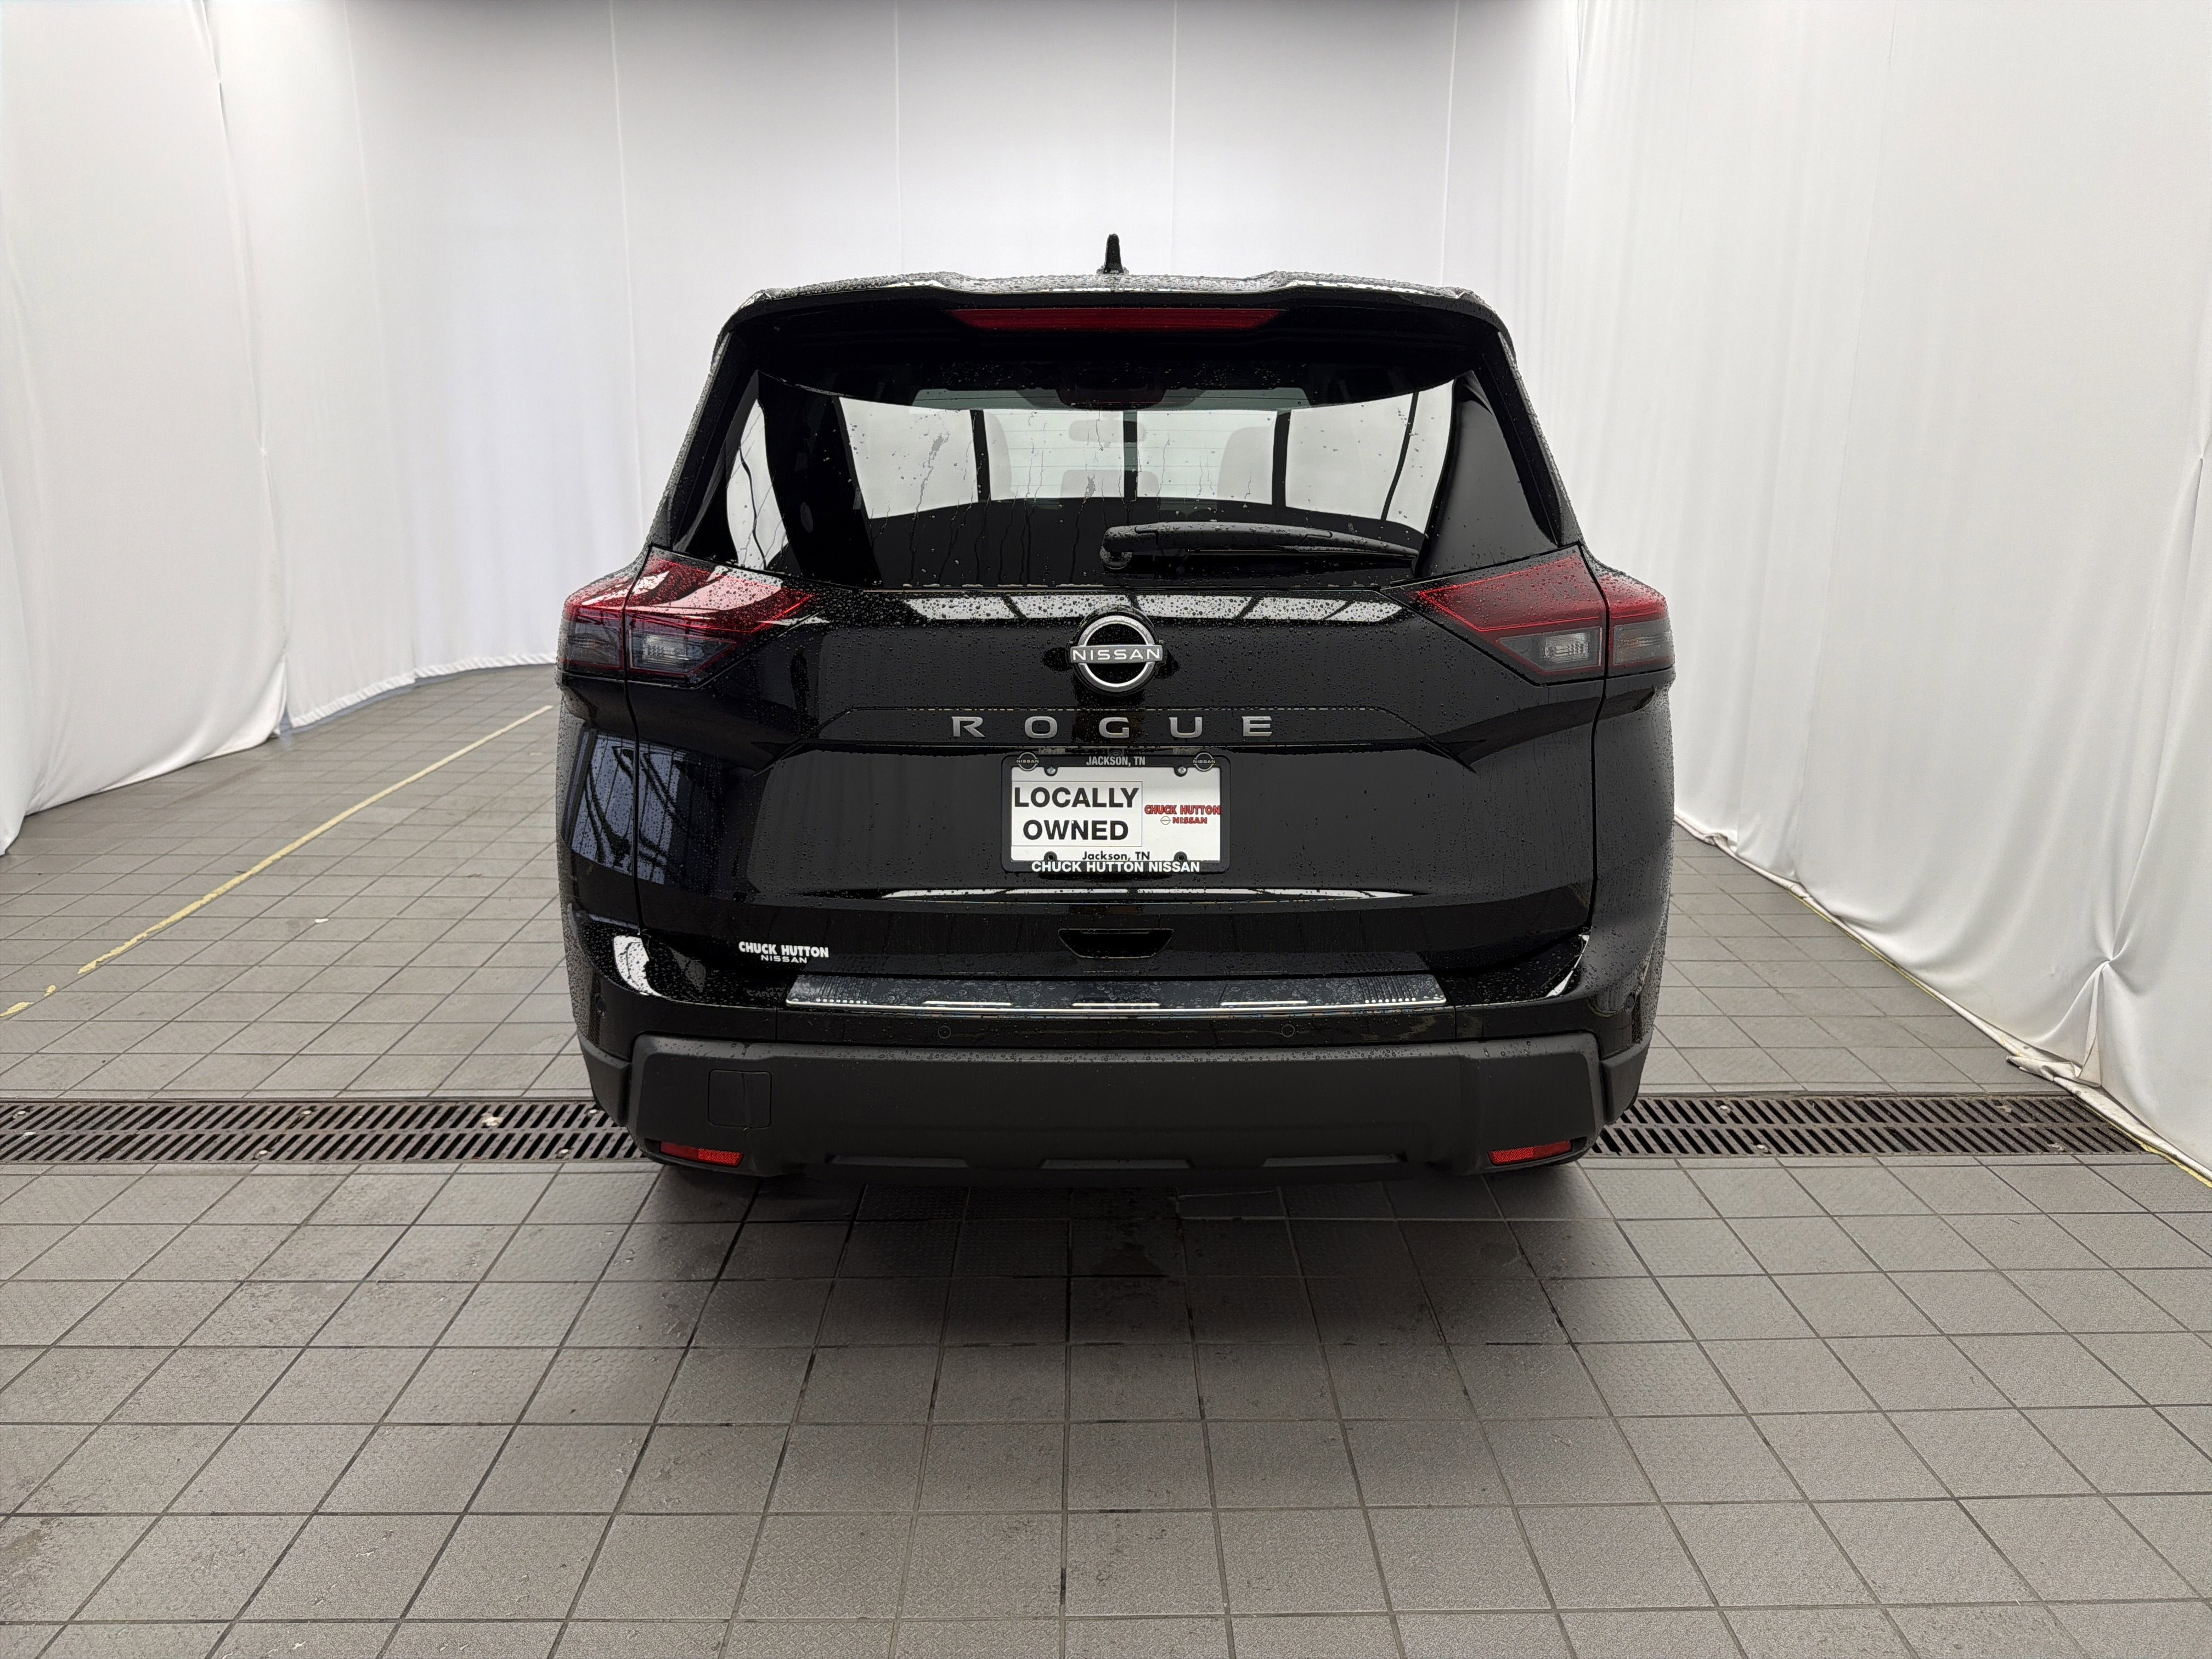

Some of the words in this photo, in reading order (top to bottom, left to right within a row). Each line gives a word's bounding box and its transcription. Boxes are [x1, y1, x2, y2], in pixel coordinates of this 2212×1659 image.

[1073, 648, 1161, 661] NISSAN
[951, 716, 1273, 738] ROGUE
[1086, 756, 1131, 768] JACKSON,
[1133, 757, 1146, 765] TN
[1014, 787, 1139, 808] LOCALLY
[1144, 804, 1177, 815] CHUCK
[1180, 805, 1221, 815] HUTTON
[1023, 820, 1129, 840] OWNED
[1082, 851, 1131, 861] Jackson,
[1135, 851, 1150, 860] TN
[1031, 861, 1081, 872] CHUCK
[1086, 861, 1144, 872] HUTTON
[1149, 861, 1200, 872] NISSAN
[738, 941, 777, 955] CHUCK
[781, 944, 830, 958] HUTTON
[760, 954, 808, 964] NISSAN
